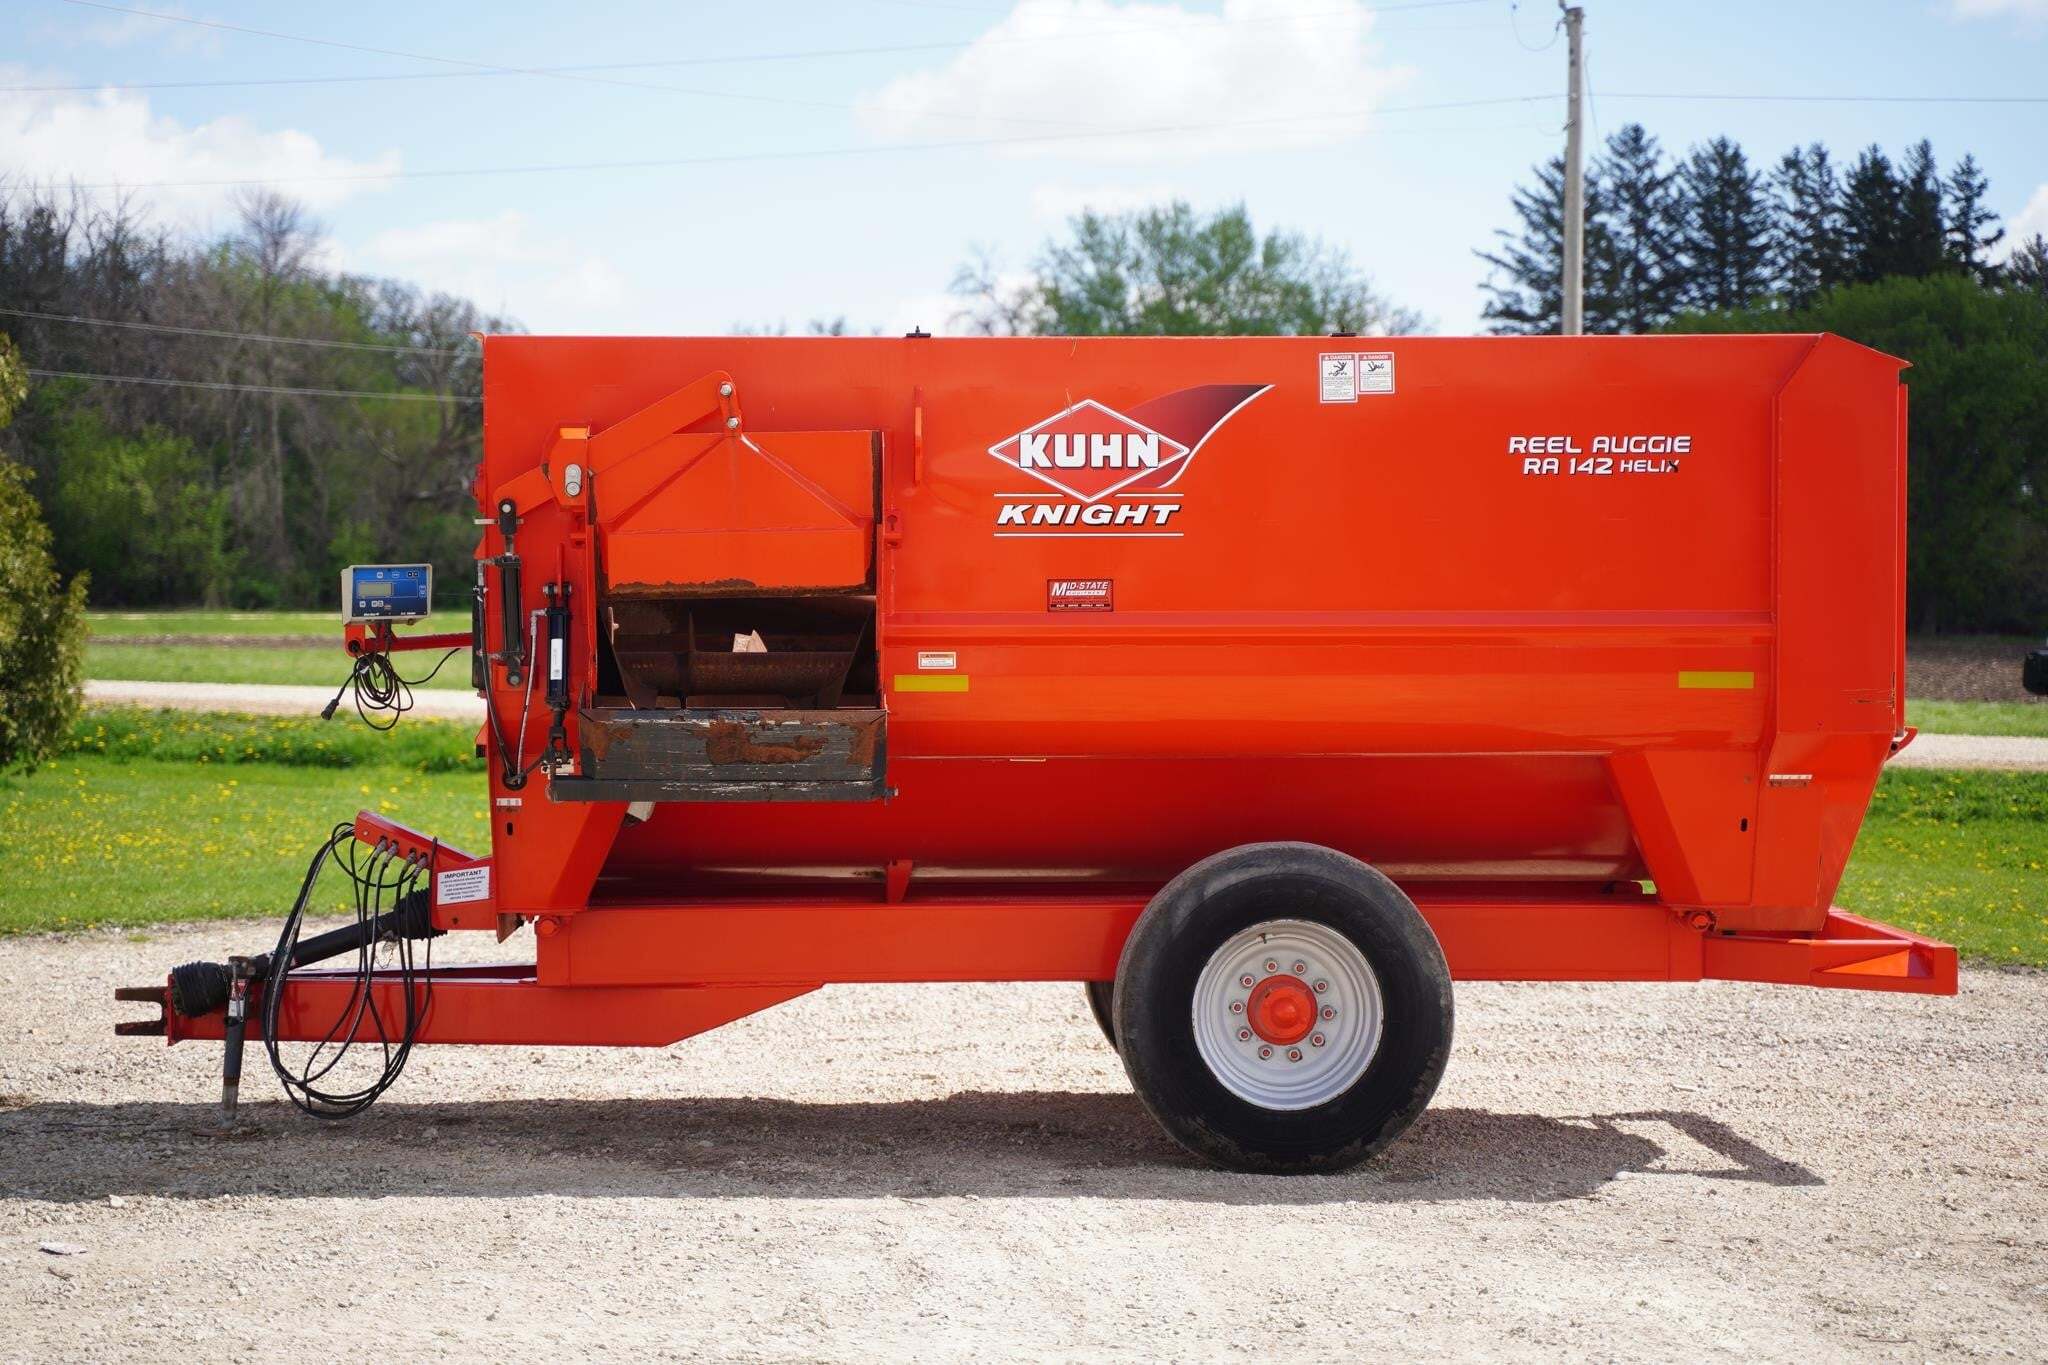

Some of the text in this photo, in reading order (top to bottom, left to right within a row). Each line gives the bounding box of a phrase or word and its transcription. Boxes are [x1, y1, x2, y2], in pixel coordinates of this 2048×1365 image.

[1019, 433, 1160, 468] KUHN
[1508, 436, 1692, 454] REEL AUGGIE
[1523, 457, 1680, 475] RA 142 HELIX
[997, 504, 1181, 526] KNIGHT
[1051, 581, 1109, 596] MID-STATE
[444, 870, 481, 879] IMPORTANT
